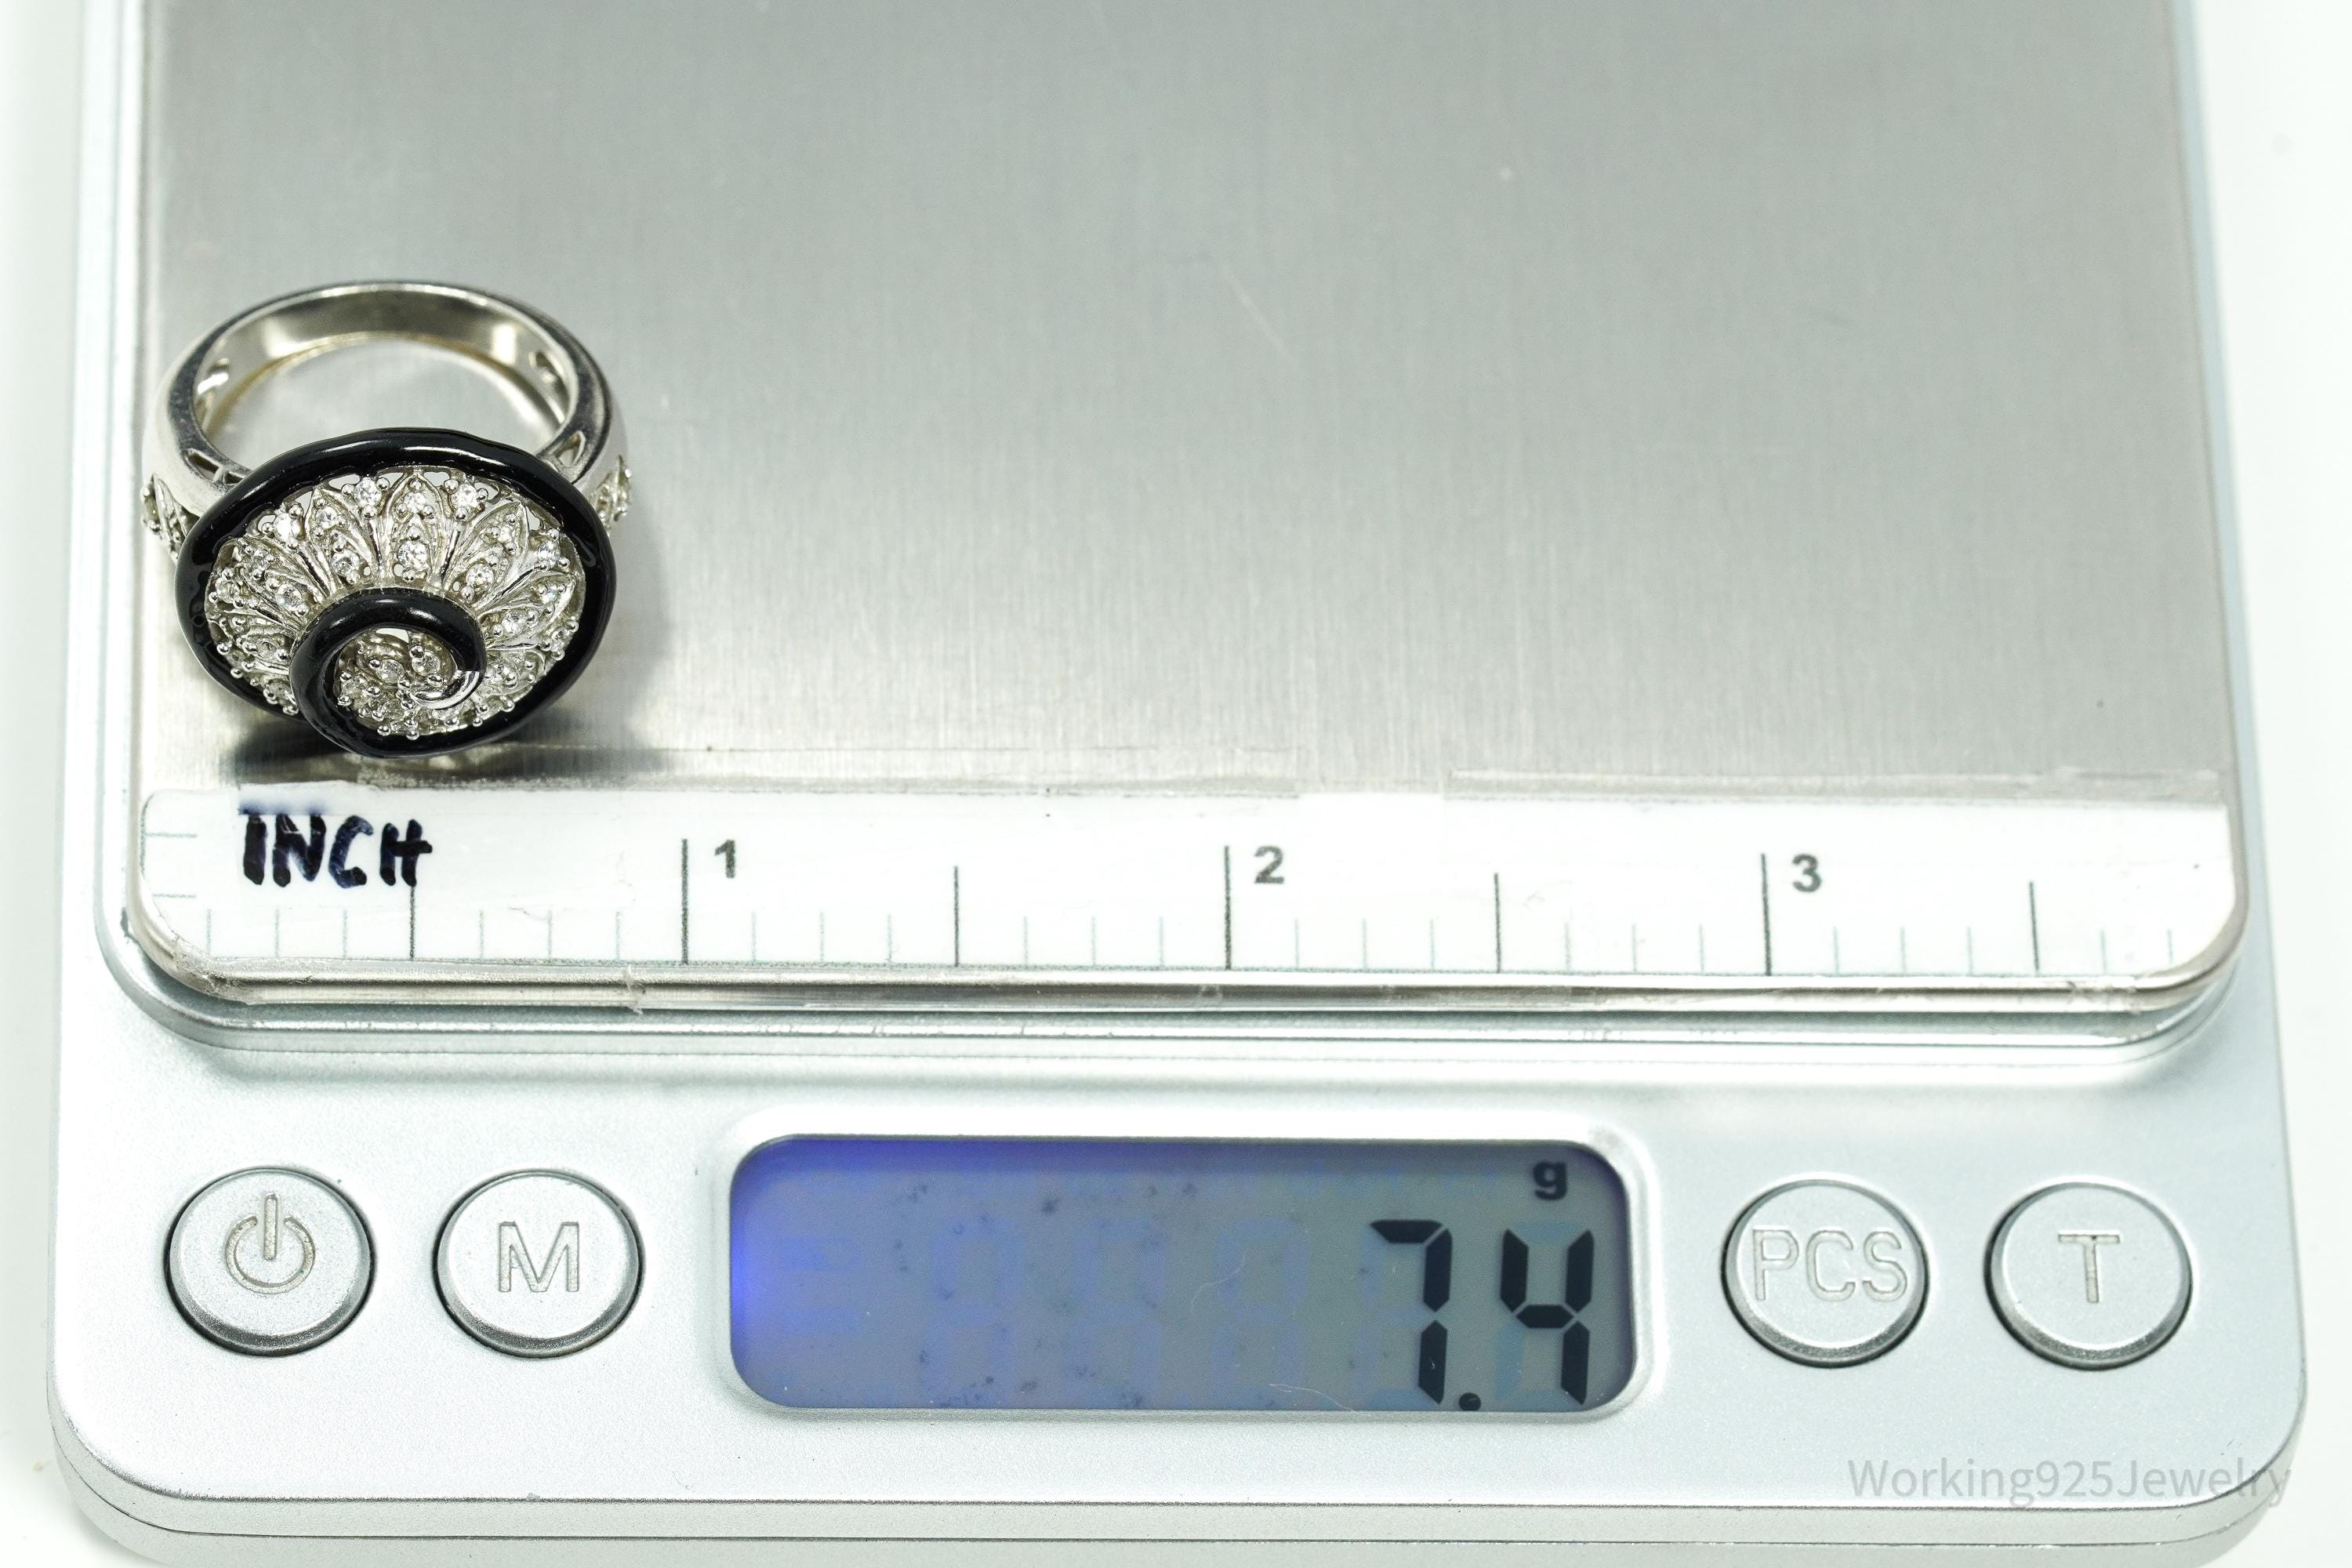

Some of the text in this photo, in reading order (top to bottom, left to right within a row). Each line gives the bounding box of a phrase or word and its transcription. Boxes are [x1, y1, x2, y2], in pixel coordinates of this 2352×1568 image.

[241, 812, 432, 887] INCH
[715, 840, 738, 878] 1
[1254, 846, 1286, 884] 2
[1792, 854, 1822, 893] 3
[1533, 1161, 1567, 1200] g
[498, 1221, 579, 1293] M
[1752, 1226, 1908, 1302] PCS
[2057, 1229, 2121, 1304] T
[1370, 1219, 1594, 1412] 7.4
